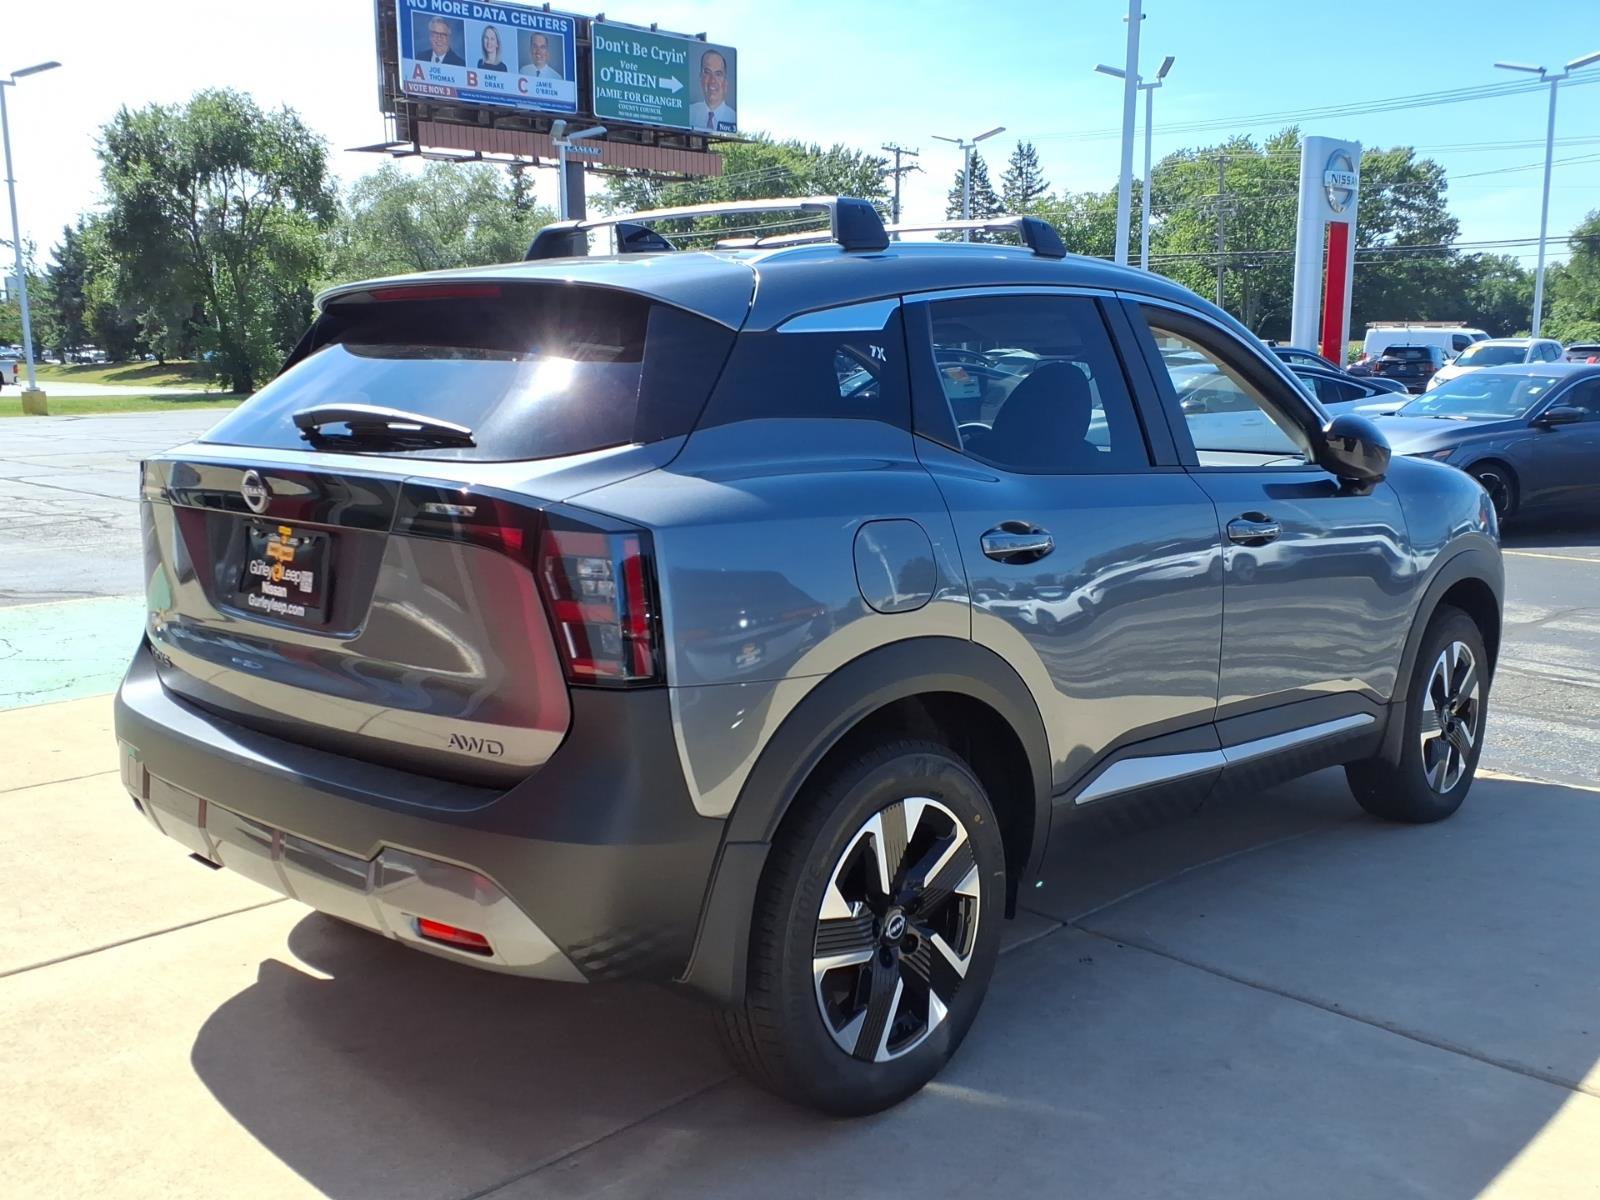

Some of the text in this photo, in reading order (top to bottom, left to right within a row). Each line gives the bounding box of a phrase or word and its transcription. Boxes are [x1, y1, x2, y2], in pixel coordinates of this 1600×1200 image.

[431, 0, 470, 16] MORE
[473, 7, 508, 23] DATA
[511, 12, 568, 32] CENTERS
[595, 35, 687, 65] Don't Be Cryin'
[412, 63, 425, 81] A
[429, 67, 441, 75] JOE
[620, 60, 639, 72] Vote
[430, 74, 456, 84] THOMAS
[466, 70, 478, 88] B
[484, 74, 497, 82] AMY
[485, 81, 505, 90] DRAKE
[535, 81, 553, 89] JAMIE
[600, 67, 657, 89] O'BRIEN
[408, 83, 451, 96] VOTE NOV. 3
[517, 77, 529, 95] C
[535, 88, 559, 96] O'BRIEN
[596, 86, 683, 109] JAMIE FOR GRANGER
[618, 103, 662, 115] COUNTY COUNCIL
[719, 122, 732, 131] Nov.
[250, 560, 273, 580] Gurley
[282, 566, 301, 585] Leep
[261, 581, 288, 598] Nissan
[447, 733, 504, 757] AWD
